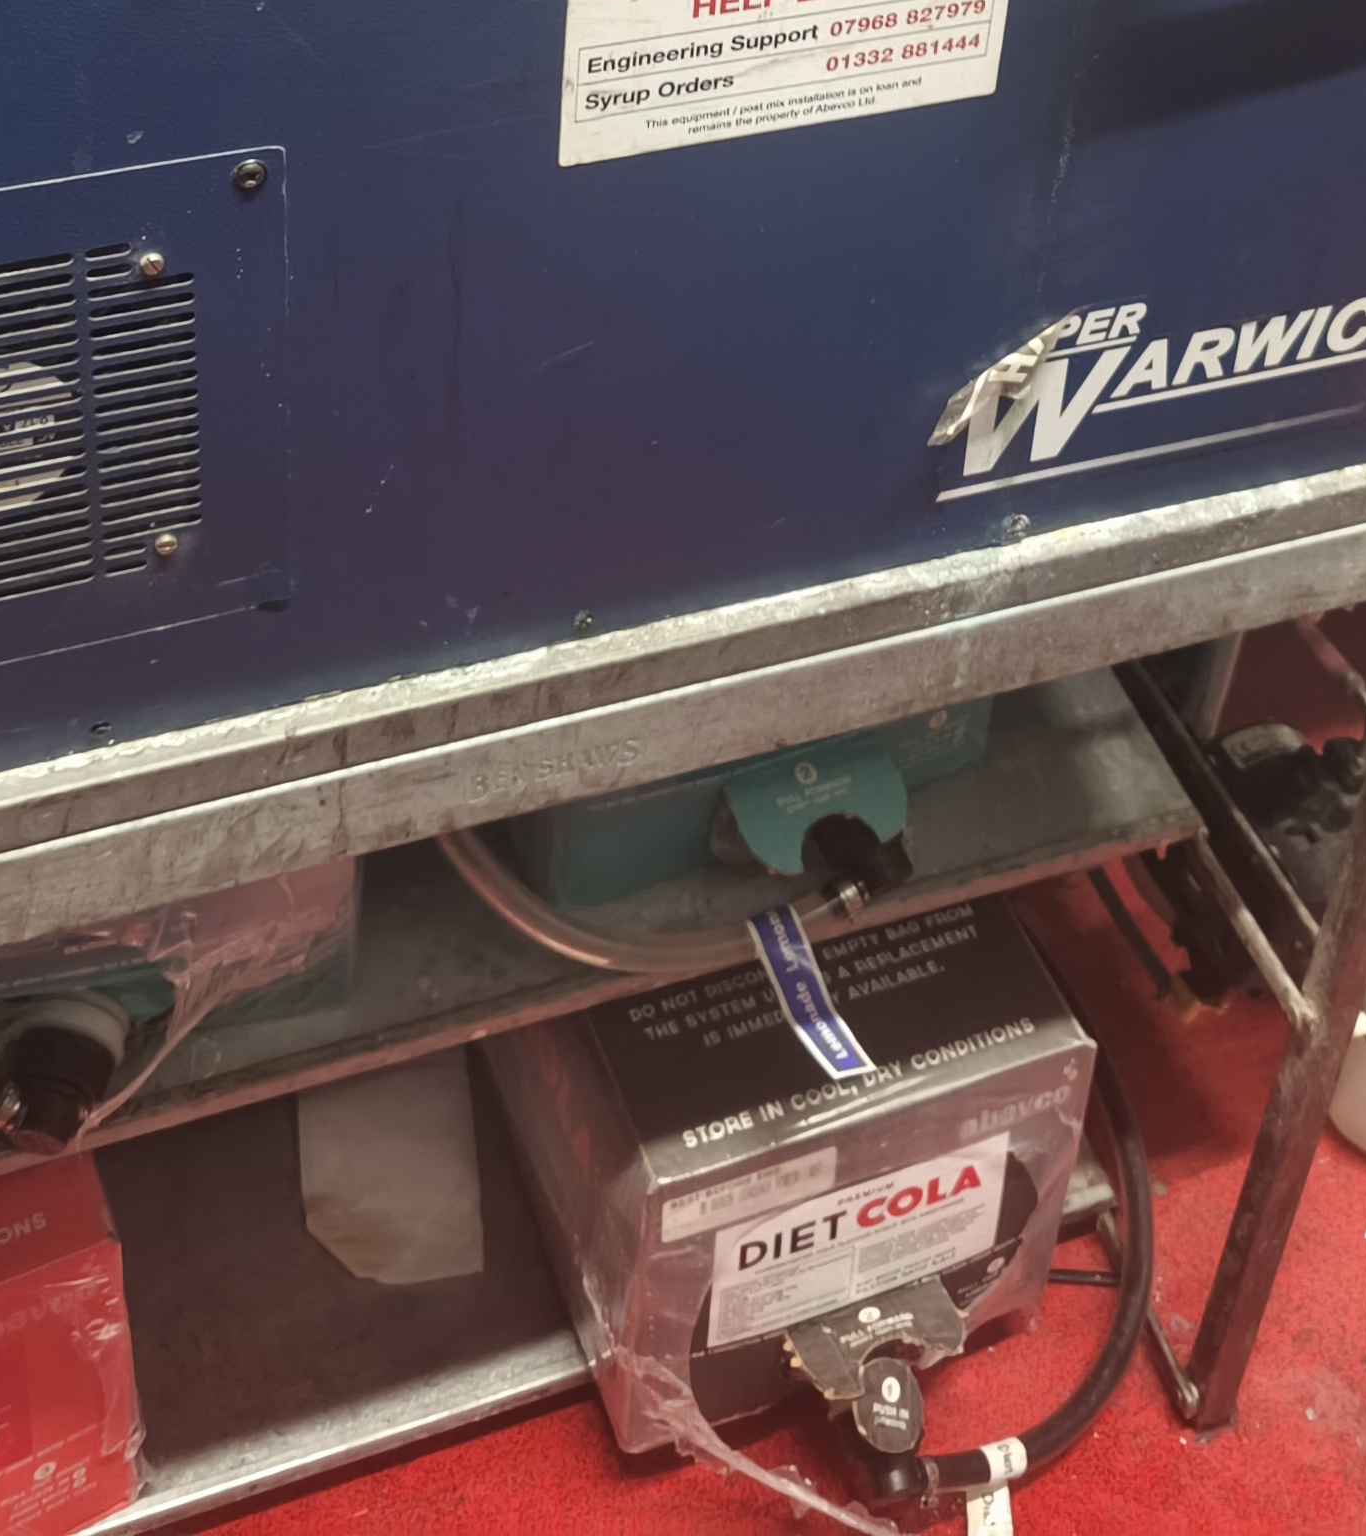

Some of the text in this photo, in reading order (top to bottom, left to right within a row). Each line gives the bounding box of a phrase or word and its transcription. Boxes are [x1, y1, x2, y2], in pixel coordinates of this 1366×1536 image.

[584, 33, 981, 111] Syrup Orders 01332 881444
[587, 39, 724, 75] Engineering
[731, 23, 819, 56] Support
[830, 11, 898, 39] 07968
[1055, 301, 1148, 347] PER
[822, 934, 881, 960] EMPTY
[796, 980, 849, 1060] Lemonade
[682, 1113, 754, 1149] STORE
[759, 1099, 785, 1122] IN
[862, 1059, 903, 1088] DRY
[911, 1016, 1035, 1069] CONDITIONS
[738, 1210, 848, 1272] DIET
[856, 1165, 982, 1229] COLA
